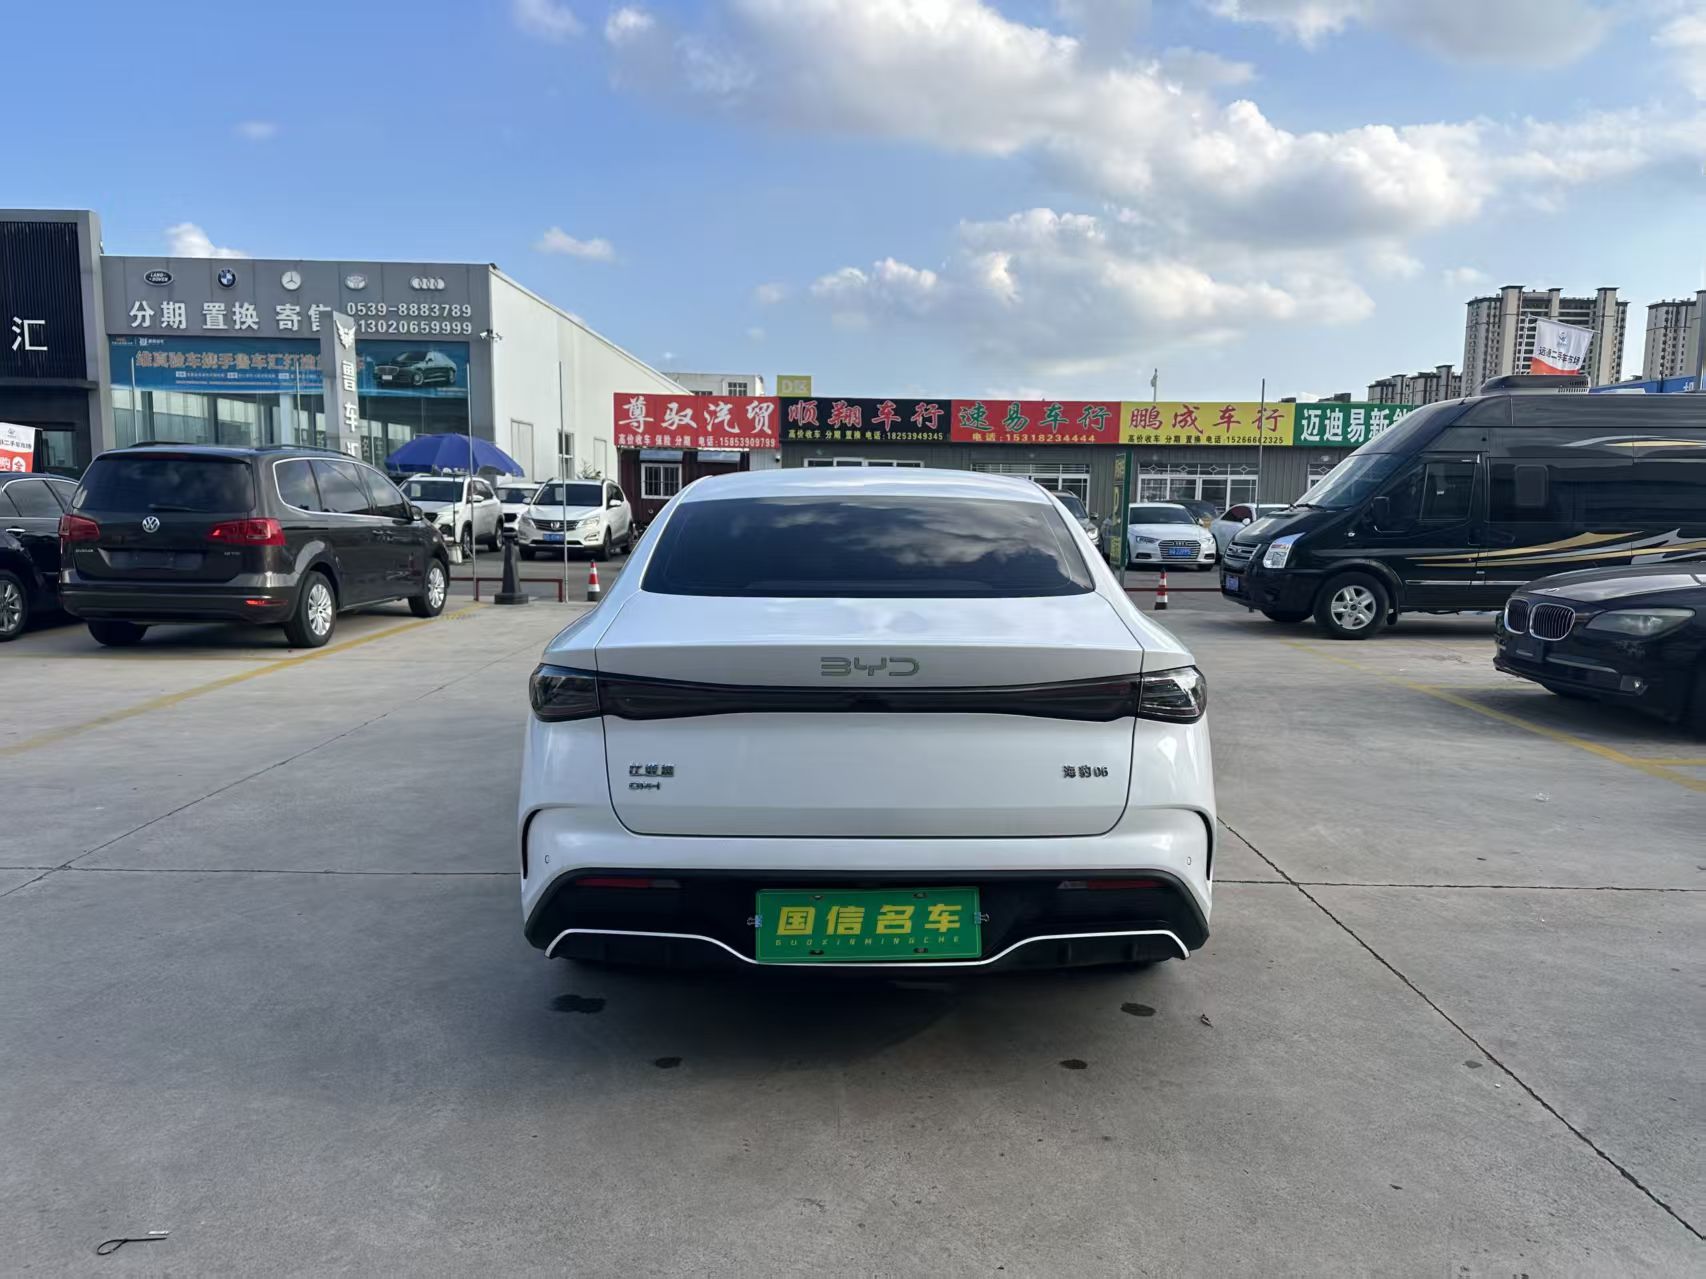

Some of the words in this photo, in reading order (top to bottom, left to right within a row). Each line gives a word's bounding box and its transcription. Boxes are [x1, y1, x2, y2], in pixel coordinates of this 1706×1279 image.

[129, 301, 187, 328] 分期
[202, 302, 259, 330] 置换
[347, 303, 472, 317] 0539-8883789
[11, 316, 49, 351] 汇
[359, 319, 472, 334] 13020659999
[788, 400, 944, 431] 顺翔车行
[959, 401, 1113, 433] 速易车行
[1129, 404, 1285, 434] 鹏成车行
[821, 657, 920, 676] BYD
[776, 904, 962, 935] 国信名车
